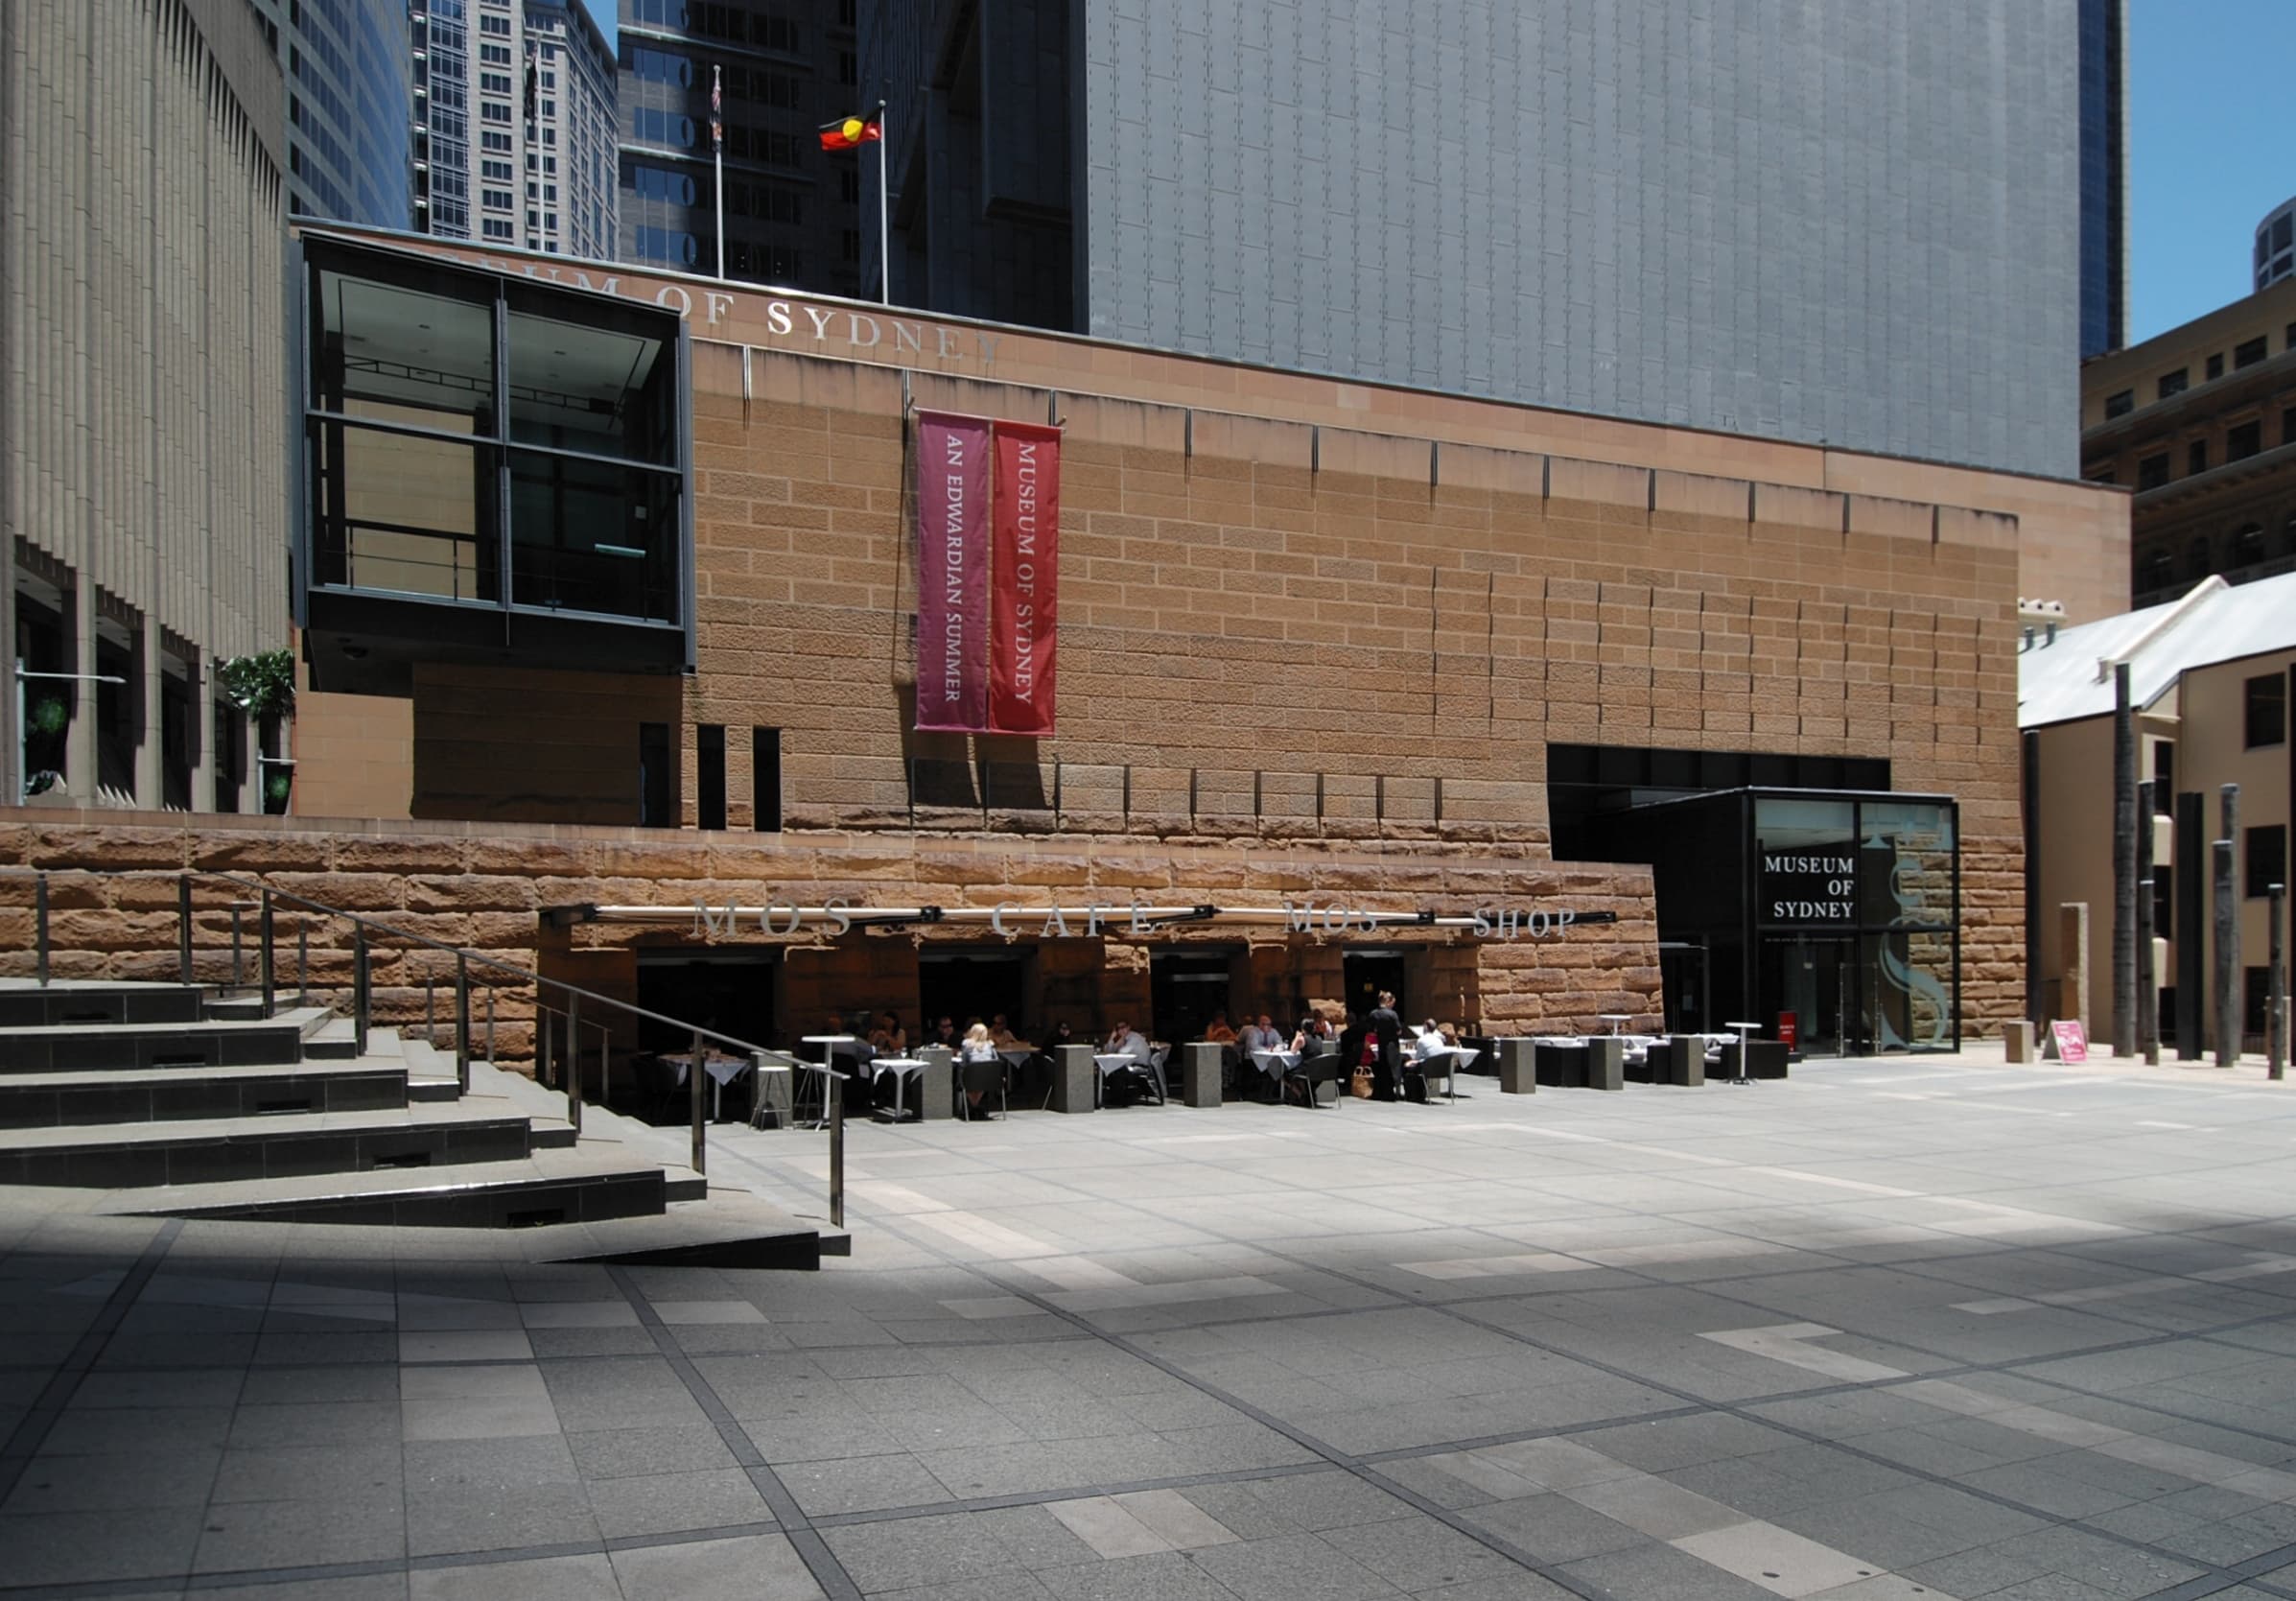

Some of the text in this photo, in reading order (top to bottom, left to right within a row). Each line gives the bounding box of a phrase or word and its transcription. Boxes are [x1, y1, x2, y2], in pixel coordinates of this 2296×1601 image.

[656, 287, 1001, 364] OF SYDNEY
[946, 434, 963, 702] AN EDWARDIAN SUMMER
[1015, 443, 1037, 705] MUSEUM OF SYDNEY
[1765, 857, 1854, 874] MUSEUM
[1828, 880, 1854, 896] OF
[689, 897, 1156, 938] MOS CAFE
[1282, 902, 1575, 938] MOS SHOP
[1773, 901, 1854, 918] SYDNEY
